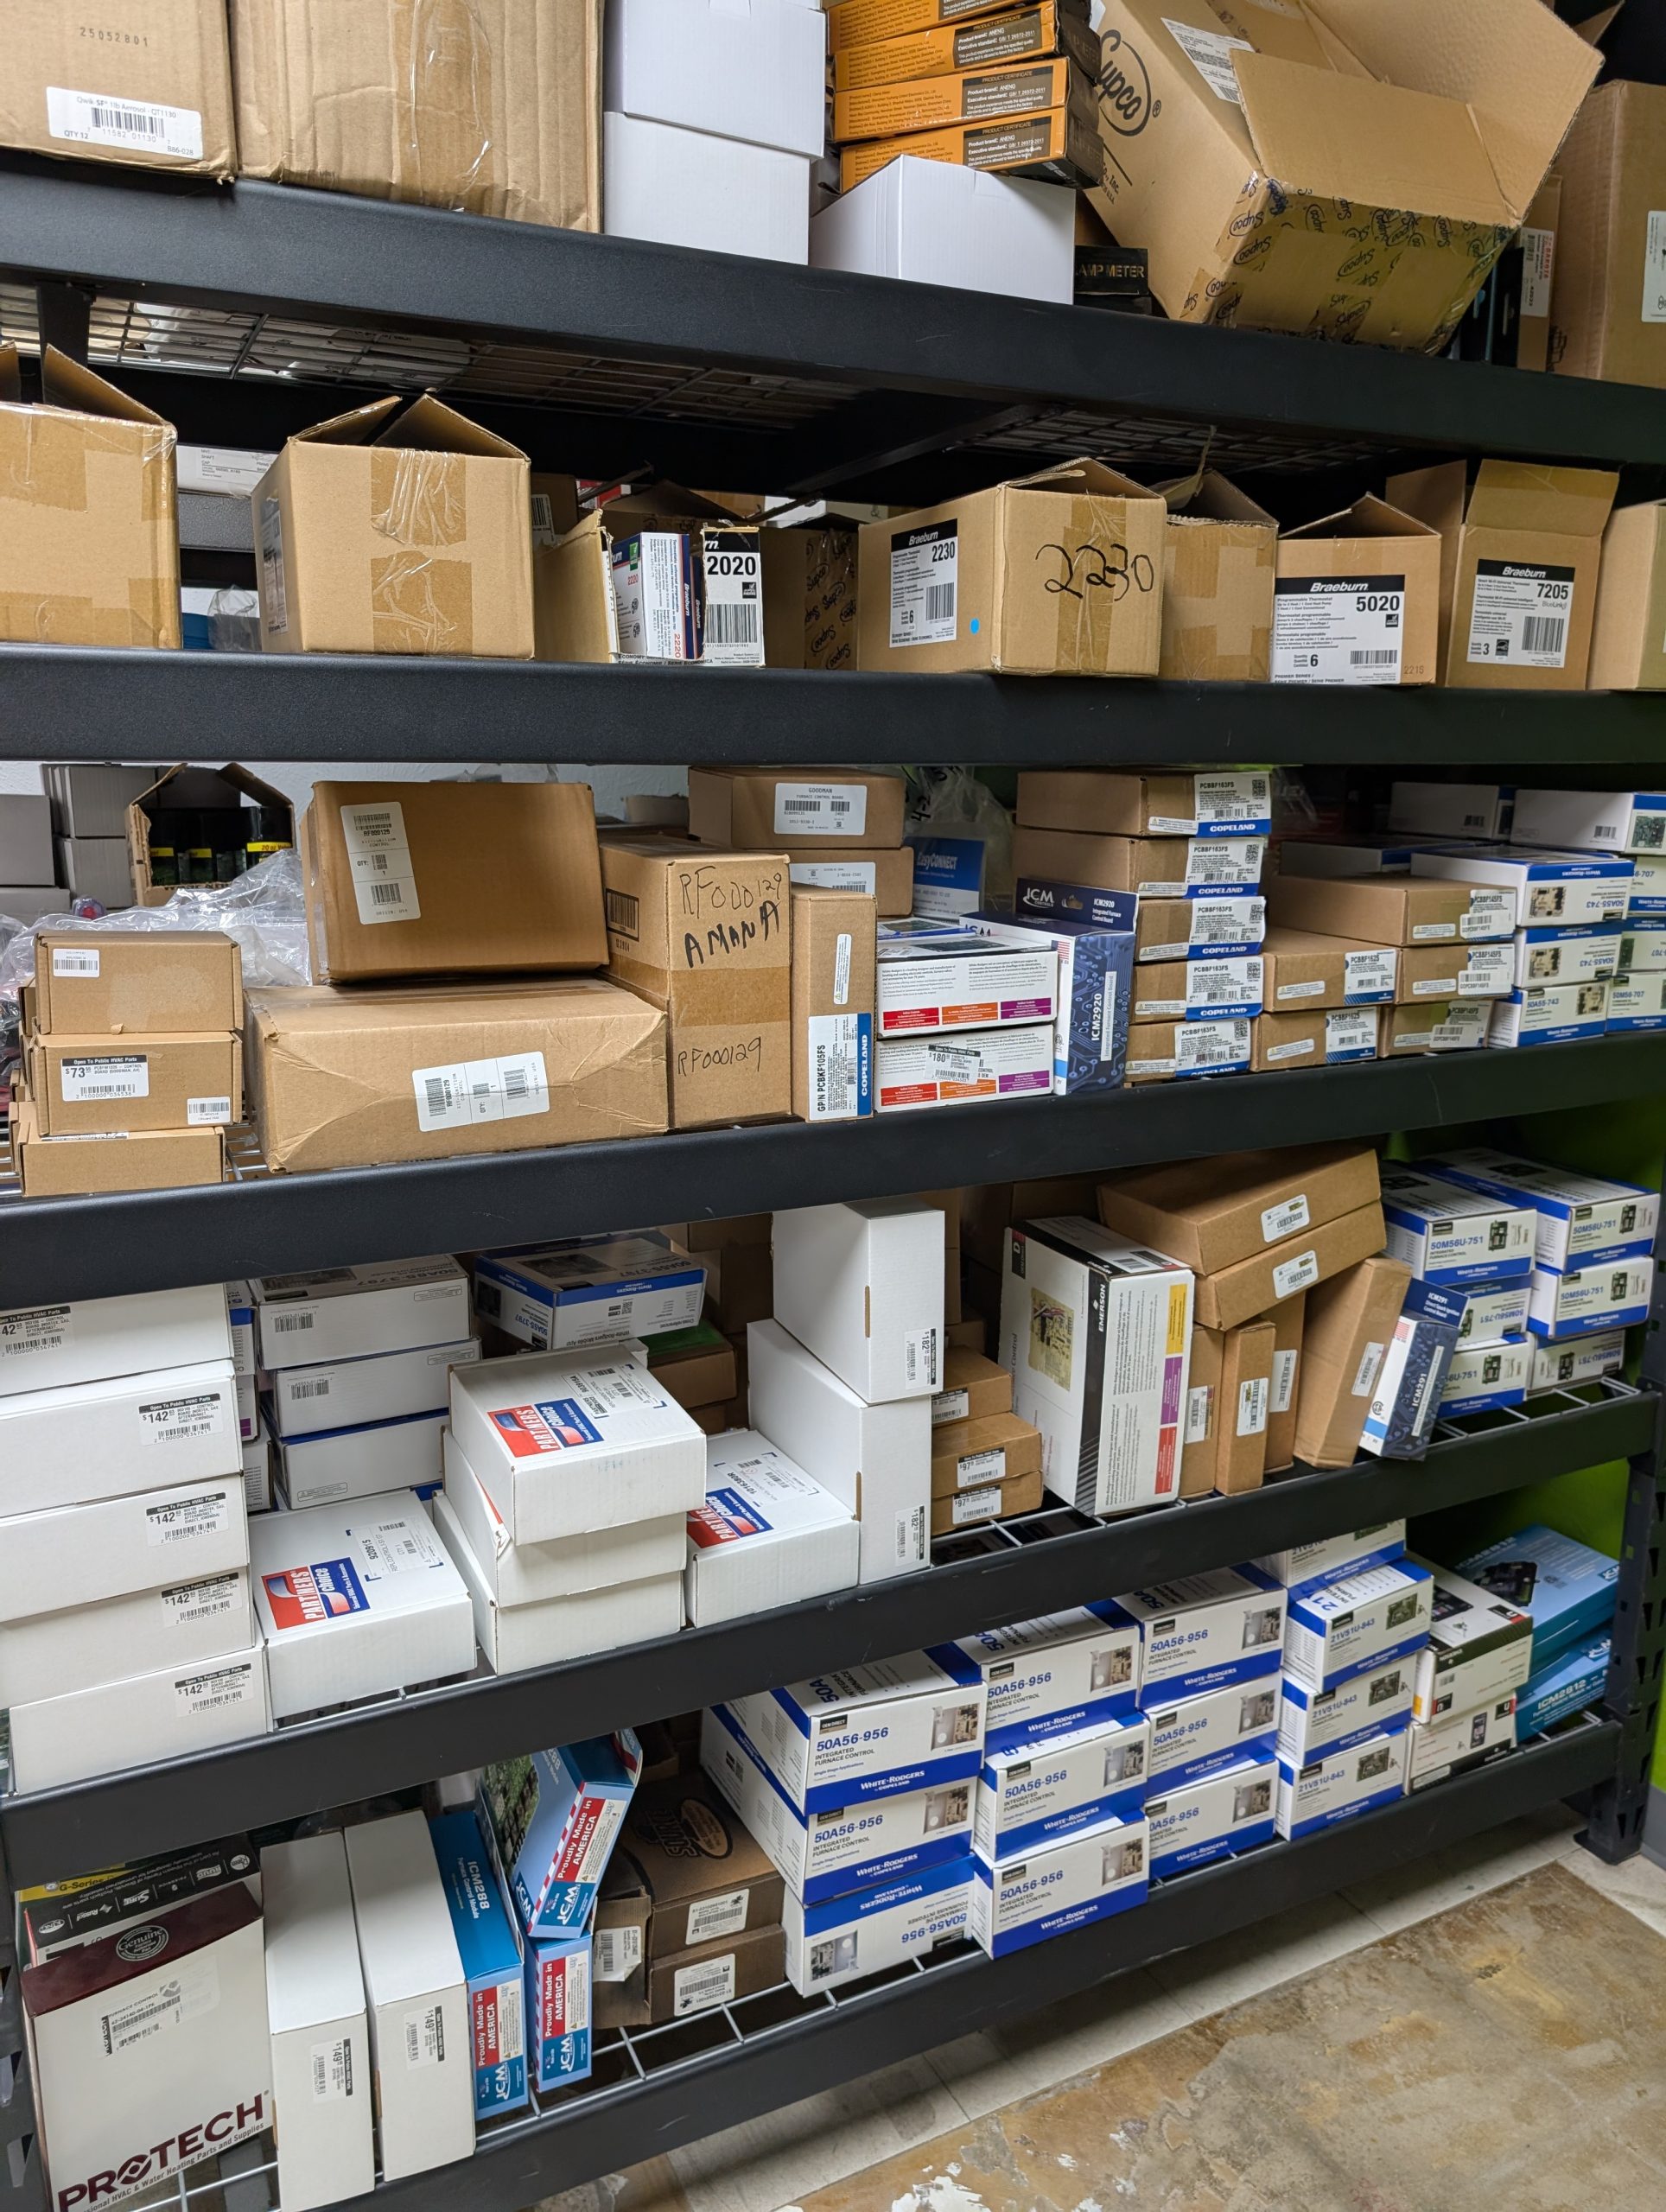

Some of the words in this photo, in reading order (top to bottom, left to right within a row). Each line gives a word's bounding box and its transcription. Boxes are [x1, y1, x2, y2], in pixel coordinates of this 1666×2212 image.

[79, 27, 149, 47] 25052801
[76, 96, 95, 105] Qwik
[121, 103, 146, 112] Aerosol
[151, 109, 176, 118] QT1130
[64, 130, 79, 138] QTY
[1106, 263, 1145, 278] METER
[909, 531, 939, 545] Braeburn
[932, 541, 956, 563] 2230
[707, 555, 756, 576] 2020
[1035, 543, 1154, 602] 2230
[1502, 566, 1547, 578] Braeburn
[1309, 582, 1370, 593] Braeburn
[1537, 582, 1569, 600] 7205
[1356, 594, 1401, 612] 5020
[909, 610, 914, 624] 6
[1310, 653, 1319, 667] 6
[1483, 643, 1490, 655] 3
[1210, 823, 1256, 833] COPELAND
[1026, 887, 1054, 904] ICM
[1198, 887, 1243, 895] COPELAND
[1093, 898, 1116, 908] ICM2920
[1202, 945, 1247, 955] COPELAND
[1091, 993, 1103, 1041] ICM2920
[1200, 1007, 1248, 1017] COPELAND
[677, 1036, 761, 1077] RF000129
[817, 1045, 826, 1092] PCBKF105FS
[1430, 1236, 1484, 1249] 50M56U-751
[1411, 1372, 1427, 1407] ICM291
[518, 1408, 560, 1451] PARTNERS
[696, 1509, 737, 1540] PARTNE
[361, 1539, 378, 1560] 920915
[290, 1569, 326, 1620] PARTNERS
[1150, 1629, 1208, 1653] 50A56-956
[988, 1672, 1052, 1699] 50A56-956
[1538, 1679, 1587, 1709] ICM2812
[987, 1693, 1021, 1707] INTEGRATED
[817, 1726, 889, 1752] 50A56-956
[1153, 1718, 1208, 1746] 50A56-956
[814, 1755, 844, 1767] FURNACE
[844, 1749, 875, 1760] CONTROL
[815, 1747, 855, 1760] INTEGRATED
[878, 1780, 910, 1791] COPELAND
[1005, 1770, 1067, 1799] 50A56-956
[1003, 1799, 1029, 1813] FURNACE
[1029, 1791, 1055, 1805] CONTROL
[1004, 1791, 1038, 1807] INTEGRATED
[814, 1815, 883, 1843] 50A56-956
[1149, 1807, 1199, 1831] 0A56-956
[557, 1841, 576, 1878] Proudly
[573, 1814, 588, 1839] Made
[584, 1800, 592, 1809] in
[572, 1815, 597, 1866] AMERICA
[812, 1843, 840, 1857] FURNACE
[841, 1837, 870, 1850] CONTROL
[813, 1836, 851, 1851] INTEGRATED
[60, 1877, 104, 1891] G-Series
[467, 1861, 490, 1910] ICM288
[1000, 1870, 1064, 1901] 50A56-956
[557, 1885, 578, 1922] ICM
[901, 1912, 967, 1943] 50A56-956
[118, 1928, 163, 1951] Genuine
[545, 1963, 552, 1973] in
[476, 1993, 483, 2002] in
[555, 1974, 563, 2020] AMERICA
[486, 2003, 496, 2050] AMERICA
[545, 2002, 554, 2037] Proudly
[561, 2037, 571, 2070] ICM
[495, 2065, 507, 2101] ICM
[58, 2094, 264, 2212] PROTECH
[111, 2187, 132, 2202] HVAC
[134, 2183, 140, 2191] &
[142, 2172, 164, 2188] Water
[167, 2158, 195, 2176] Heating
[197, 2146, 217, 2160] Parts
[219, 2139, 232, 2150] and
[233, 2123, 264, 2142] Supplies
